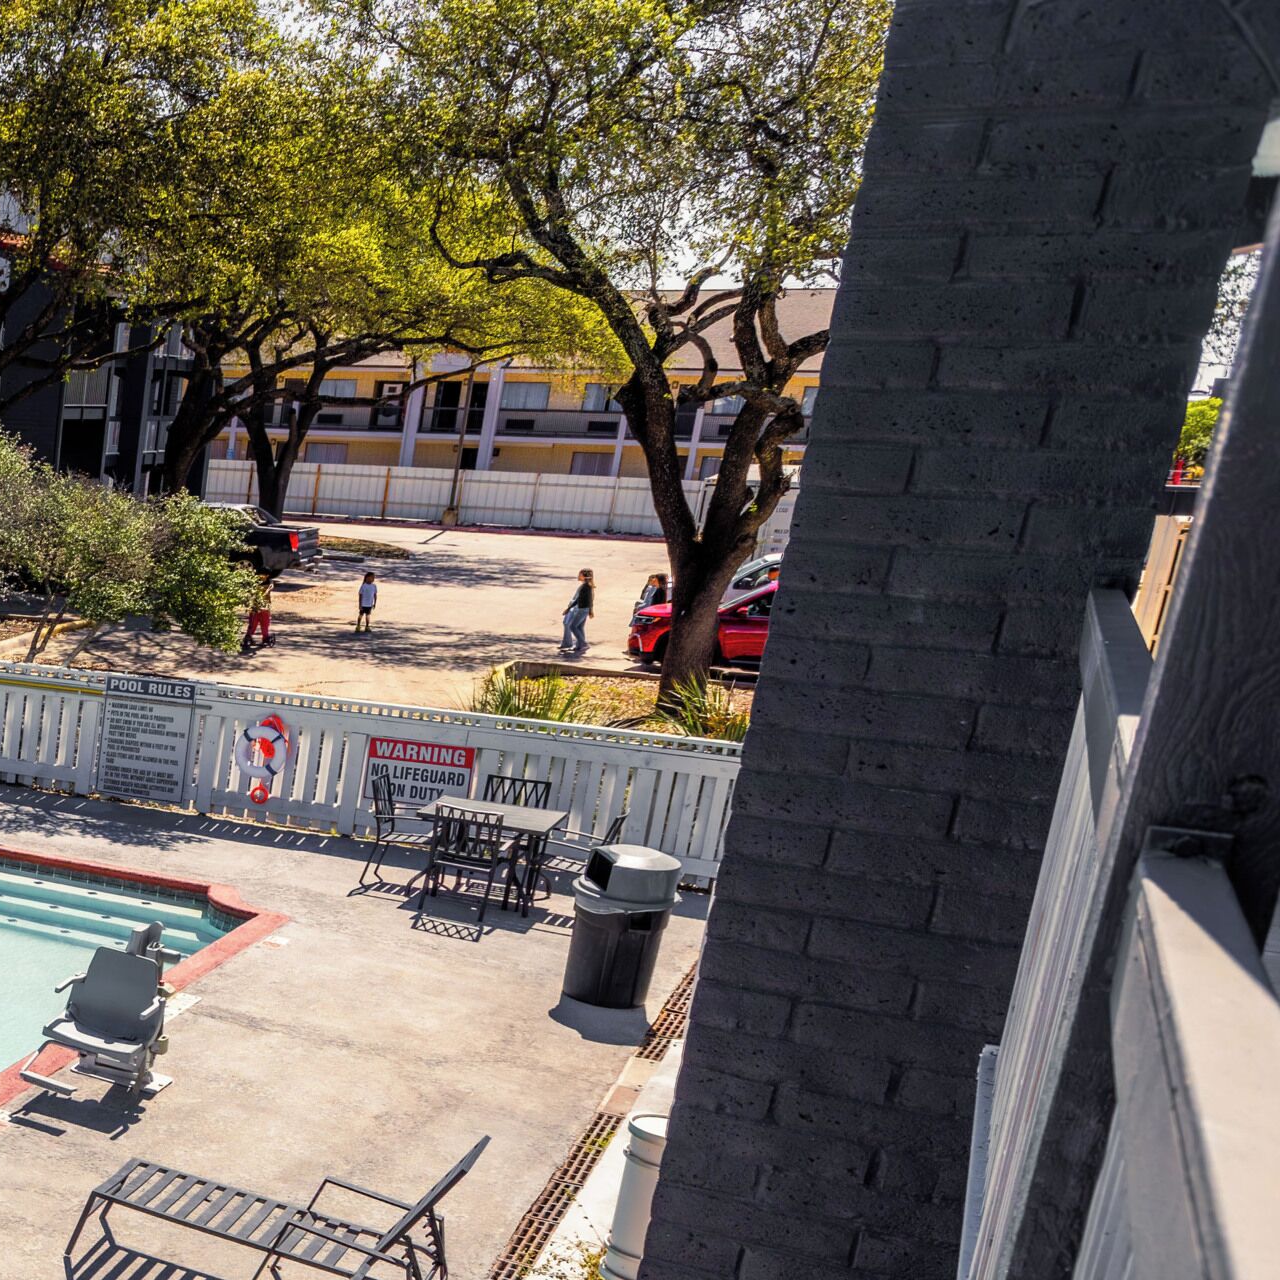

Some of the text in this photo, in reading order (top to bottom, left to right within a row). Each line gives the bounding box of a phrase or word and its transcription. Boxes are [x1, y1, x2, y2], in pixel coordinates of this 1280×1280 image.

[110, 678, 192, 698] POOL RULES
[375, 741, 466, 766] WARNING
[371, 763, 465, 787] NO LIFEGUARD
[389, 783, 444, 801] ON DUTY
